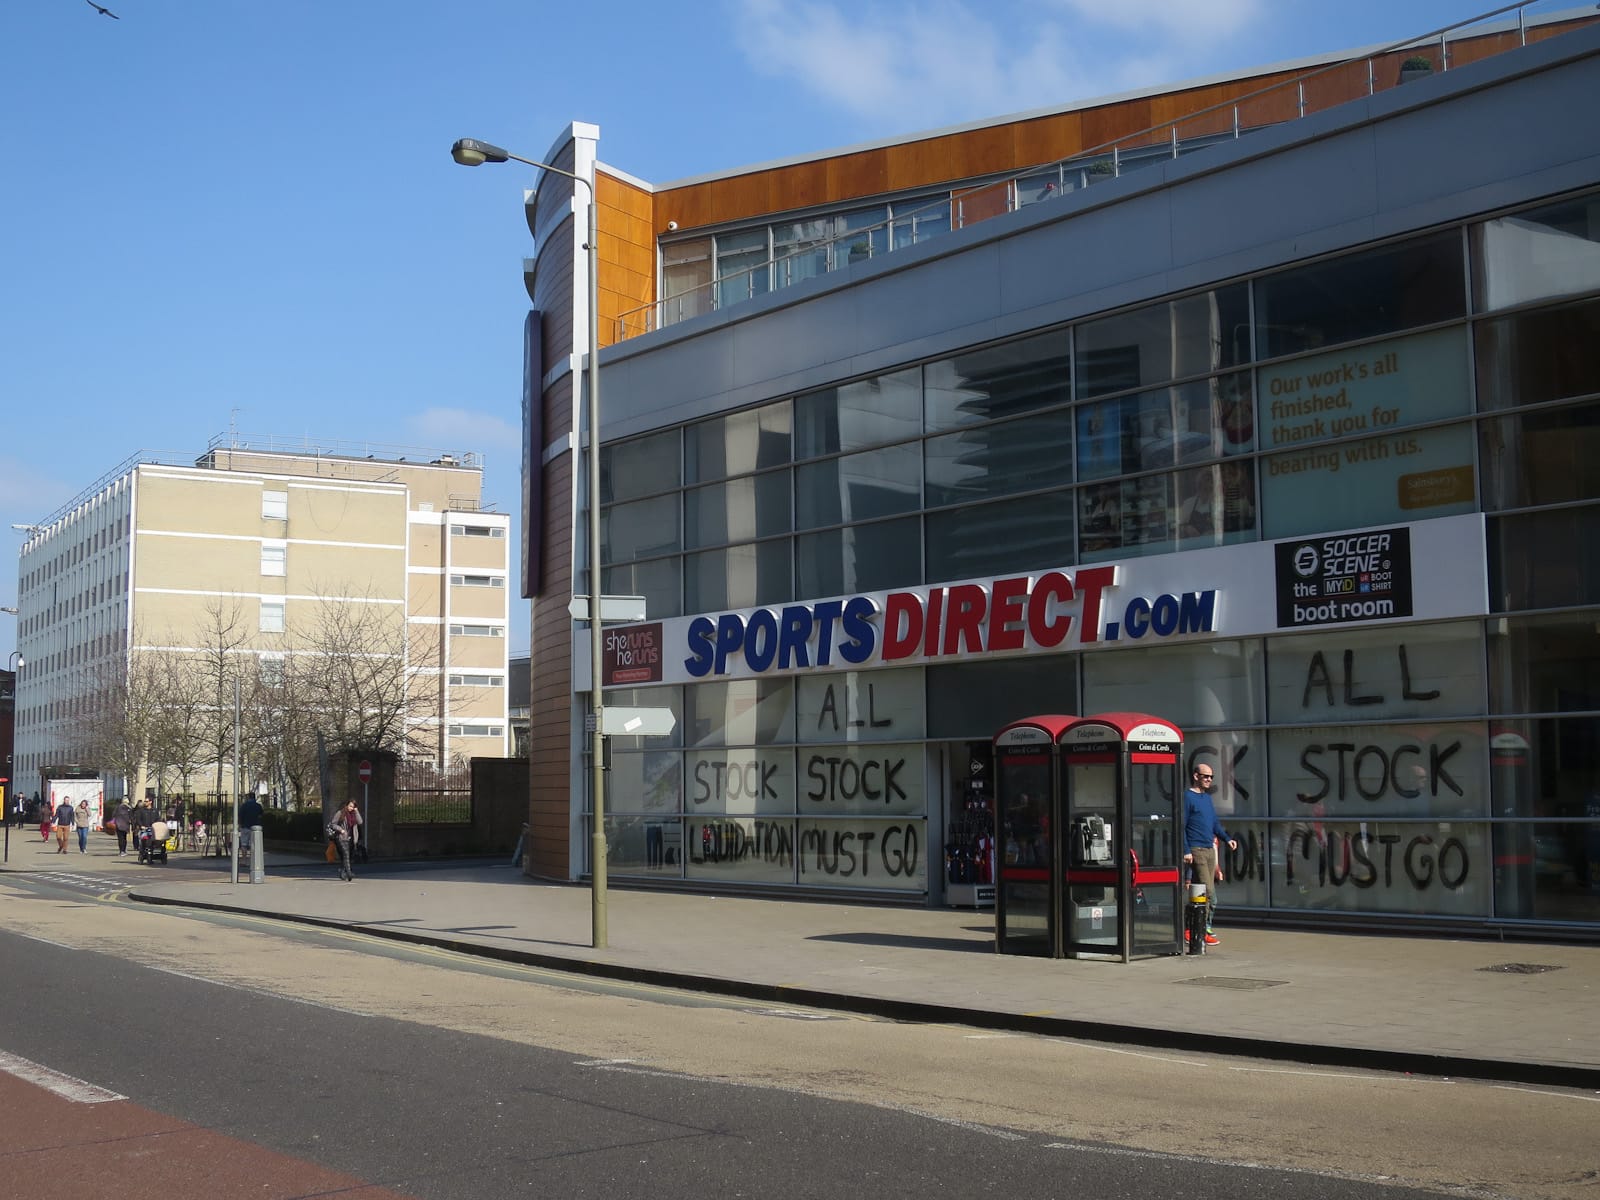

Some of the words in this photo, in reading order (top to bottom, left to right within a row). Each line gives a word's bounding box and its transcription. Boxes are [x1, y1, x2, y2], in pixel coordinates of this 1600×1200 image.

[1270, 377, 1302, 396] Our
[1307, 362, 1368, 388] work's
[1374, 352, 1398, 376] all
[1270, 388, 1352, 420] finished,
[1272, 418, 1325, 444] thank
[1331, 414, 1367, 436] you
[1372, 406, 1401, 427] for
[1268, 450, 1340, 476] bearing
[1345, 440, 1389, 464] with
[1394, 438, 1423, 456] us.
[1322, 534, 1391, 558] SOCCER
[1322, 554, 1381, 576] SCENE
[1293, 582, 1317, 597] the
[1371, 572, 1392, 582] BOOT
[1294, 600, 1337, 622] boot
[1341, 599, 1394, 618] room
[1302, 644, 1440, 707] ALL
[818, 683, 893, 731] ALL
[694, 760, 778, 804] STOCK
[808, 755, 907, 804] STOCK
[1296, 740, 1464, 803] STOCK
[801, 829, 875, 876] MUST
[881, 823, 918, 877] GO
[1287, 831, 1401, 887] MUST
[1404, 836, 1469, 889] GO
